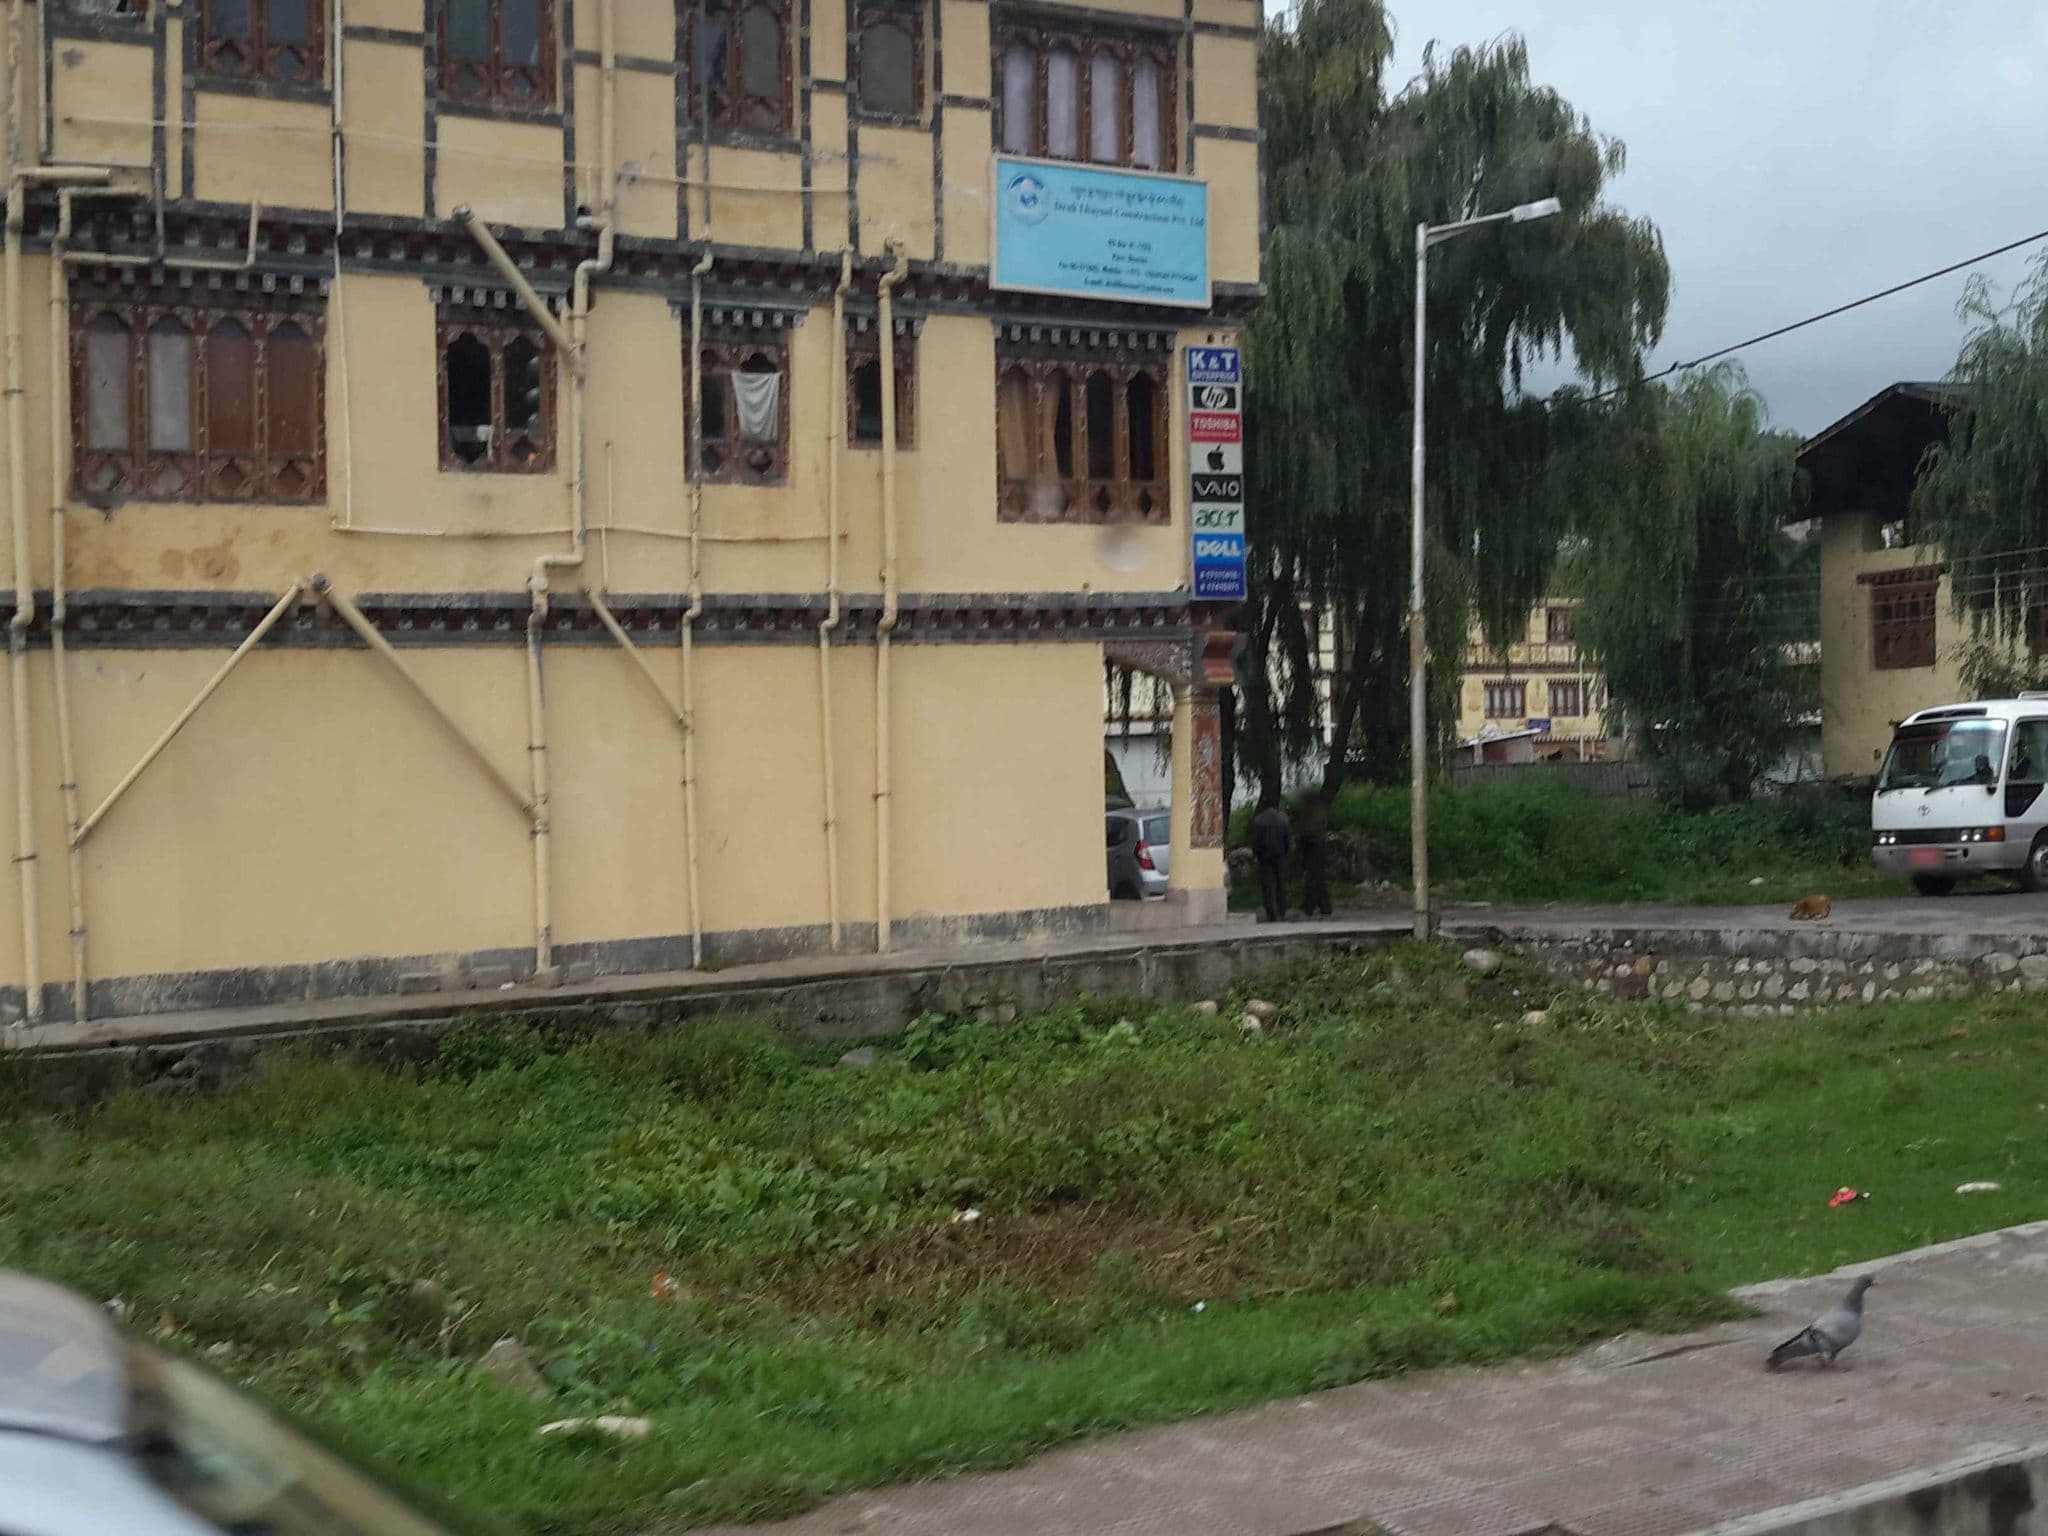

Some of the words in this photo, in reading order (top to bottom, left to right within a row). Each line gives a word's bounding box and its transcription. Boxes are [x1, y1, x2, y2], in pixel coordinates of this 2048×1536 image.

[1192, 416, 1237, 431] TOSHIBA
[1194, 480, 1240, 497] VAIO
[1195, 509, 1239, 528] acer
[1196, 540, 1241, 557] DELL
